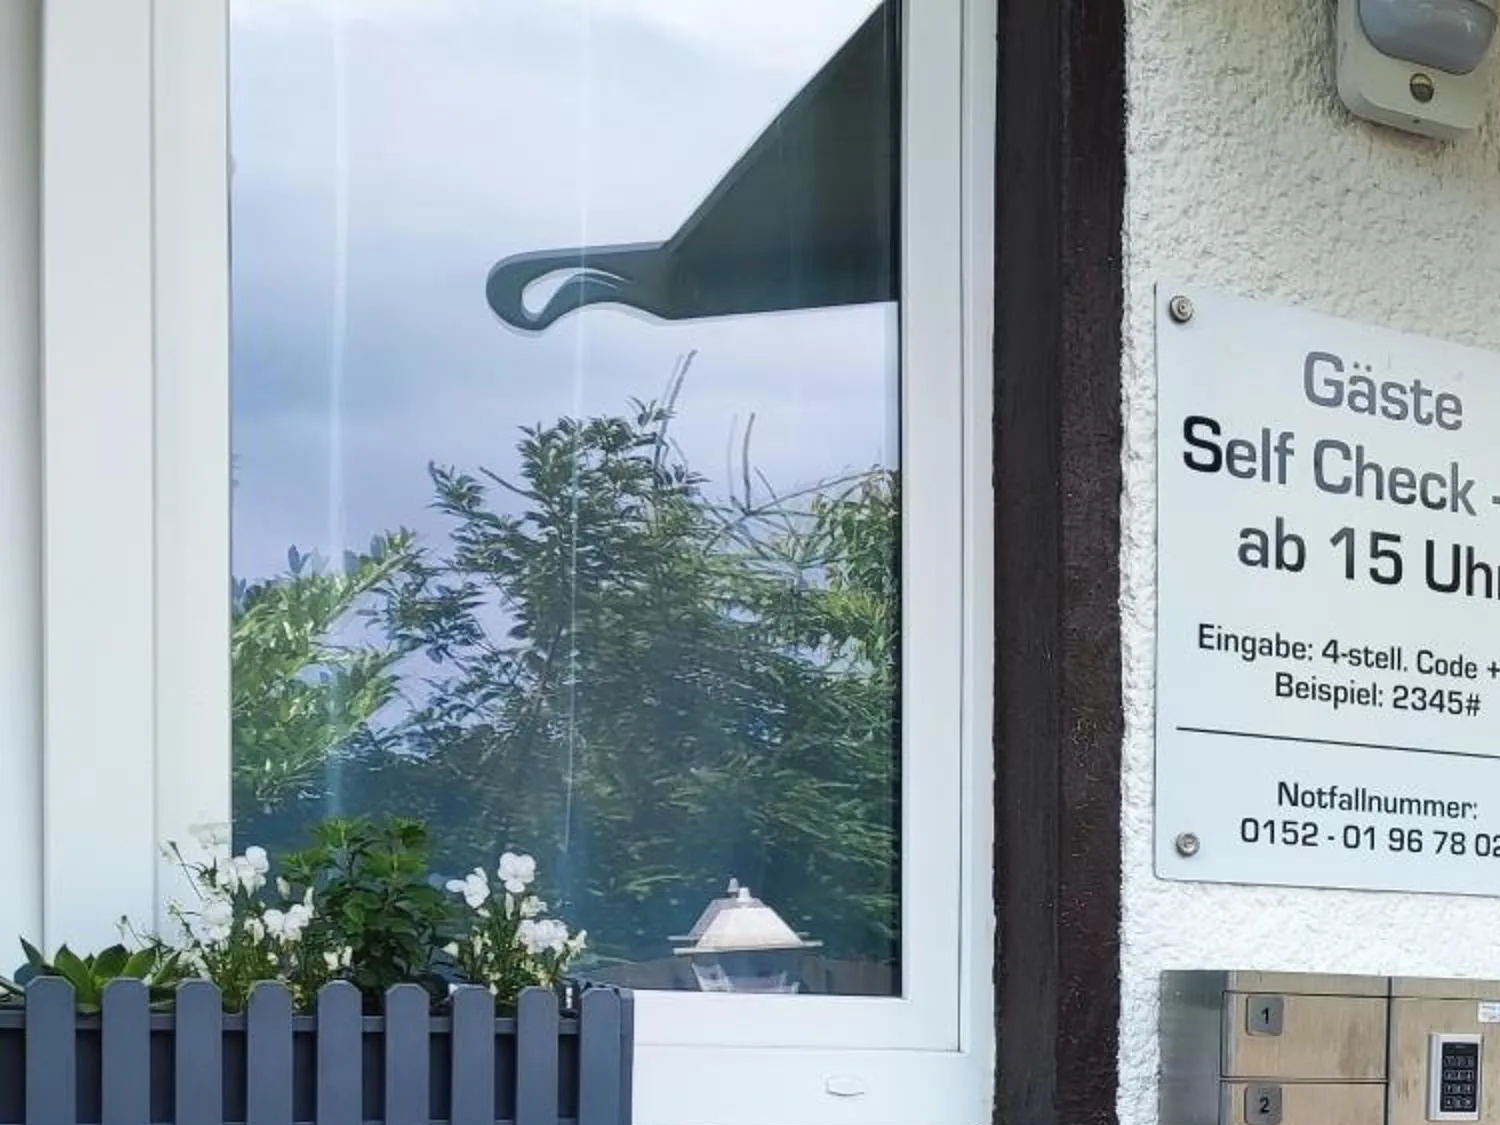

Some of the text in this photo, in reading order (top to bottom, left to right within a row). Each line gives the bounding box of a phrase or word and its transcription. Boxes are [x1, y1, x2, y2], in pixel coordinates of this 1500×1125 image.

[1304, 352, 1462, 430] Gäste
[1184, 416, 1294, 484] Self
[1314, 440, 1476, 516] Check
[1238, 517, 1306, 572] ab
[1330, 528, 1402, 585] 15
[1199, 624, 1312, 662] Eingabe:
[1322, 640, 1407, 672] 4-stell.
[1417, 650, 1477, 679] Code
[1487, 661, 1500, 678] +
[1276, 672, 1480, 716] Beispiel: 2345#
[1277, 782, 1478, 820] Notfallnummer:
[1241, 818, 1318, 846] 0152
[1342, 825, 1376, 850] 01
[1389, 829, 1423, 853] 96
[1434, 831, 1466, 856] 78
[1262, 1008, 1269, 1024] 1
[1260, 1097, 1270, 1114] 2
